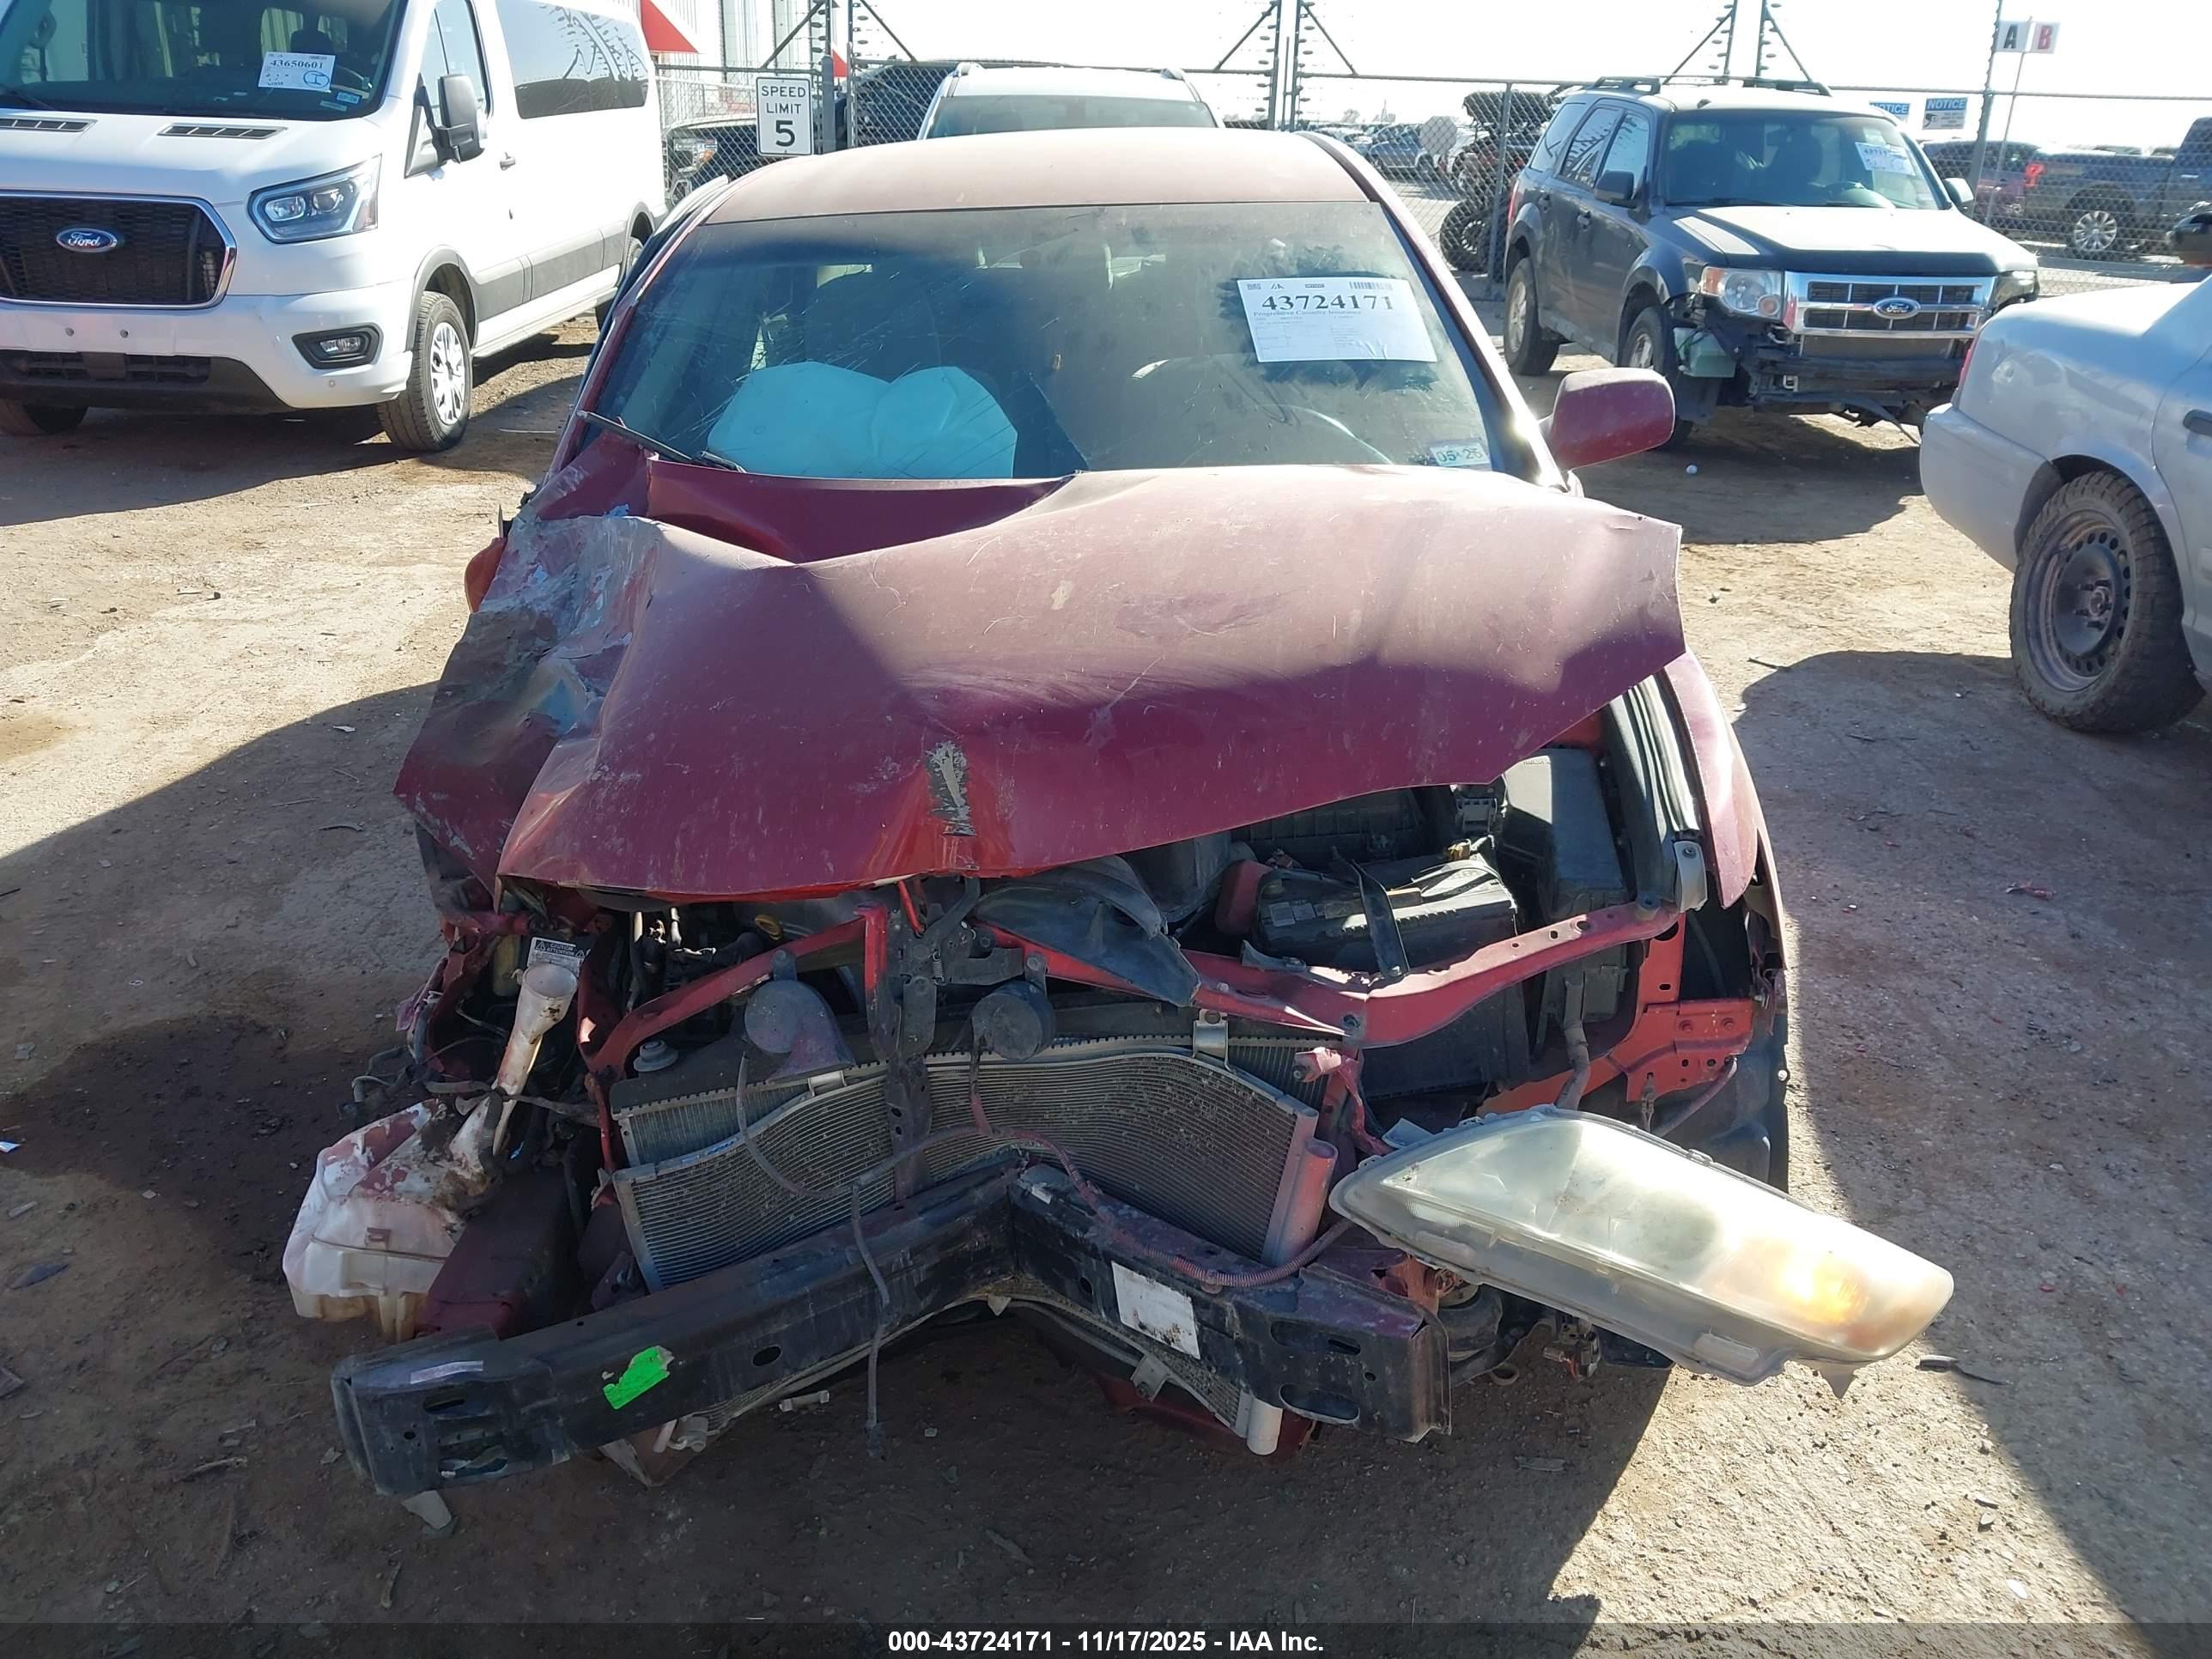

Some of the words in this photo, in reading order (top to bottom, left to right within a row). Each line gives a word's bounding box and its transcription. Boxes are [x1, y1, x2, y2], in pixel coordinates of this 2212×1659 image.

[2003, 24, 2018, 48] A
[2038, 25, 2052, 49] B
[270, 59, 324, 70] 43650601
[761, 85, 806, 98] SPEED
[766, 102, 802, 114] LIMIT
[1875, 104, 1908, 113] OTICE
[1927, 99, 1966, 110] NOTICE
[775, 119, 795, 147] 5
[68, 232, 101, 246] Ford
[1261, 295, 1394, 311] 43724171
